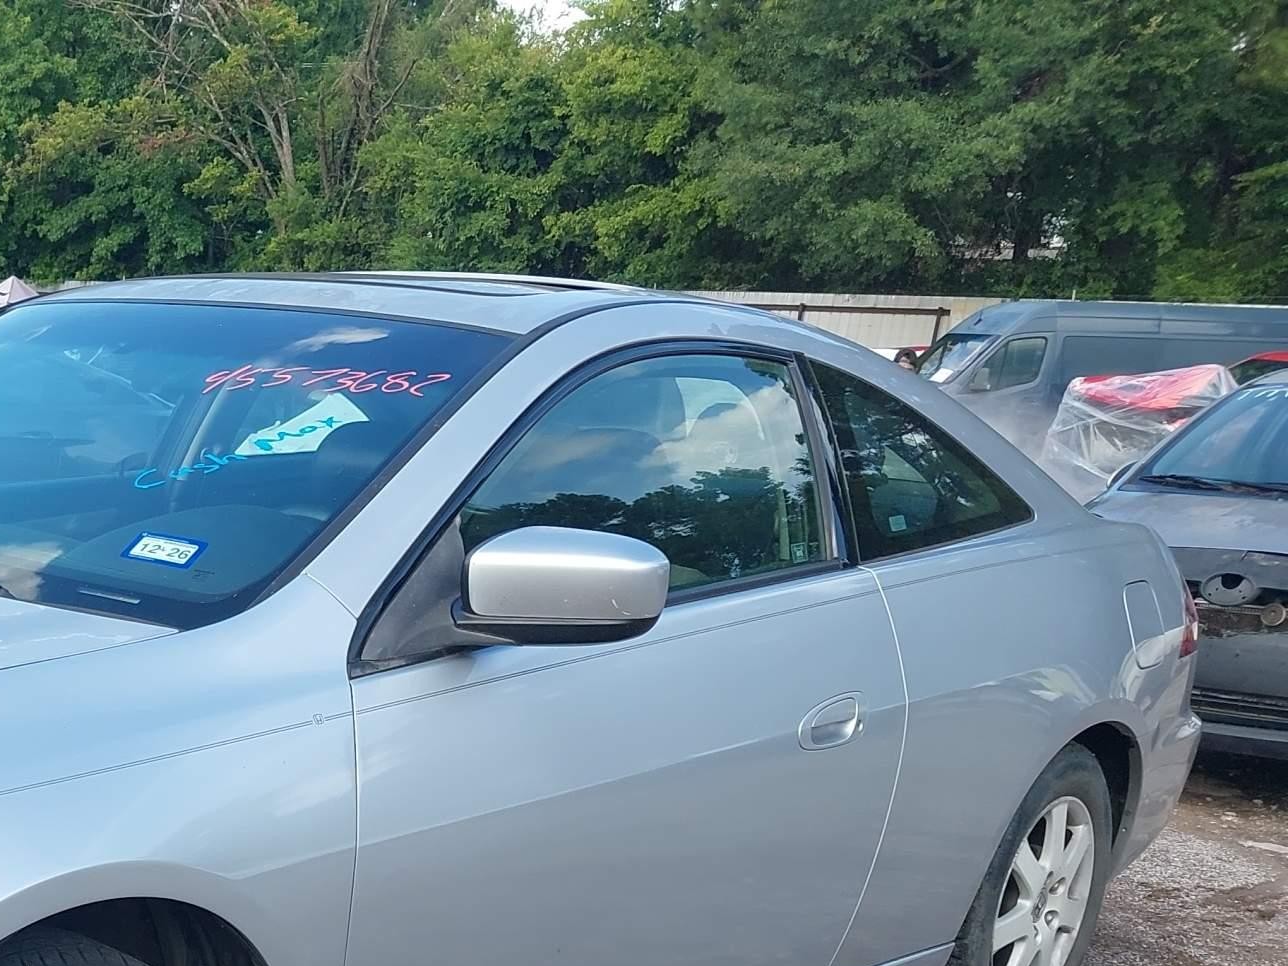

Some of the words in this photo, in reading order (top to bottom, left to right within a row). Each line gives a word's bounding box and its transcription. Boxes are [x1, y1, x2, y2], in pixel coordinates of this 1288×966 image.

[202, 365, 451, 397] 45573682
[140, 543, 162, 554] 12
[166, 547, 191, 560] 26
